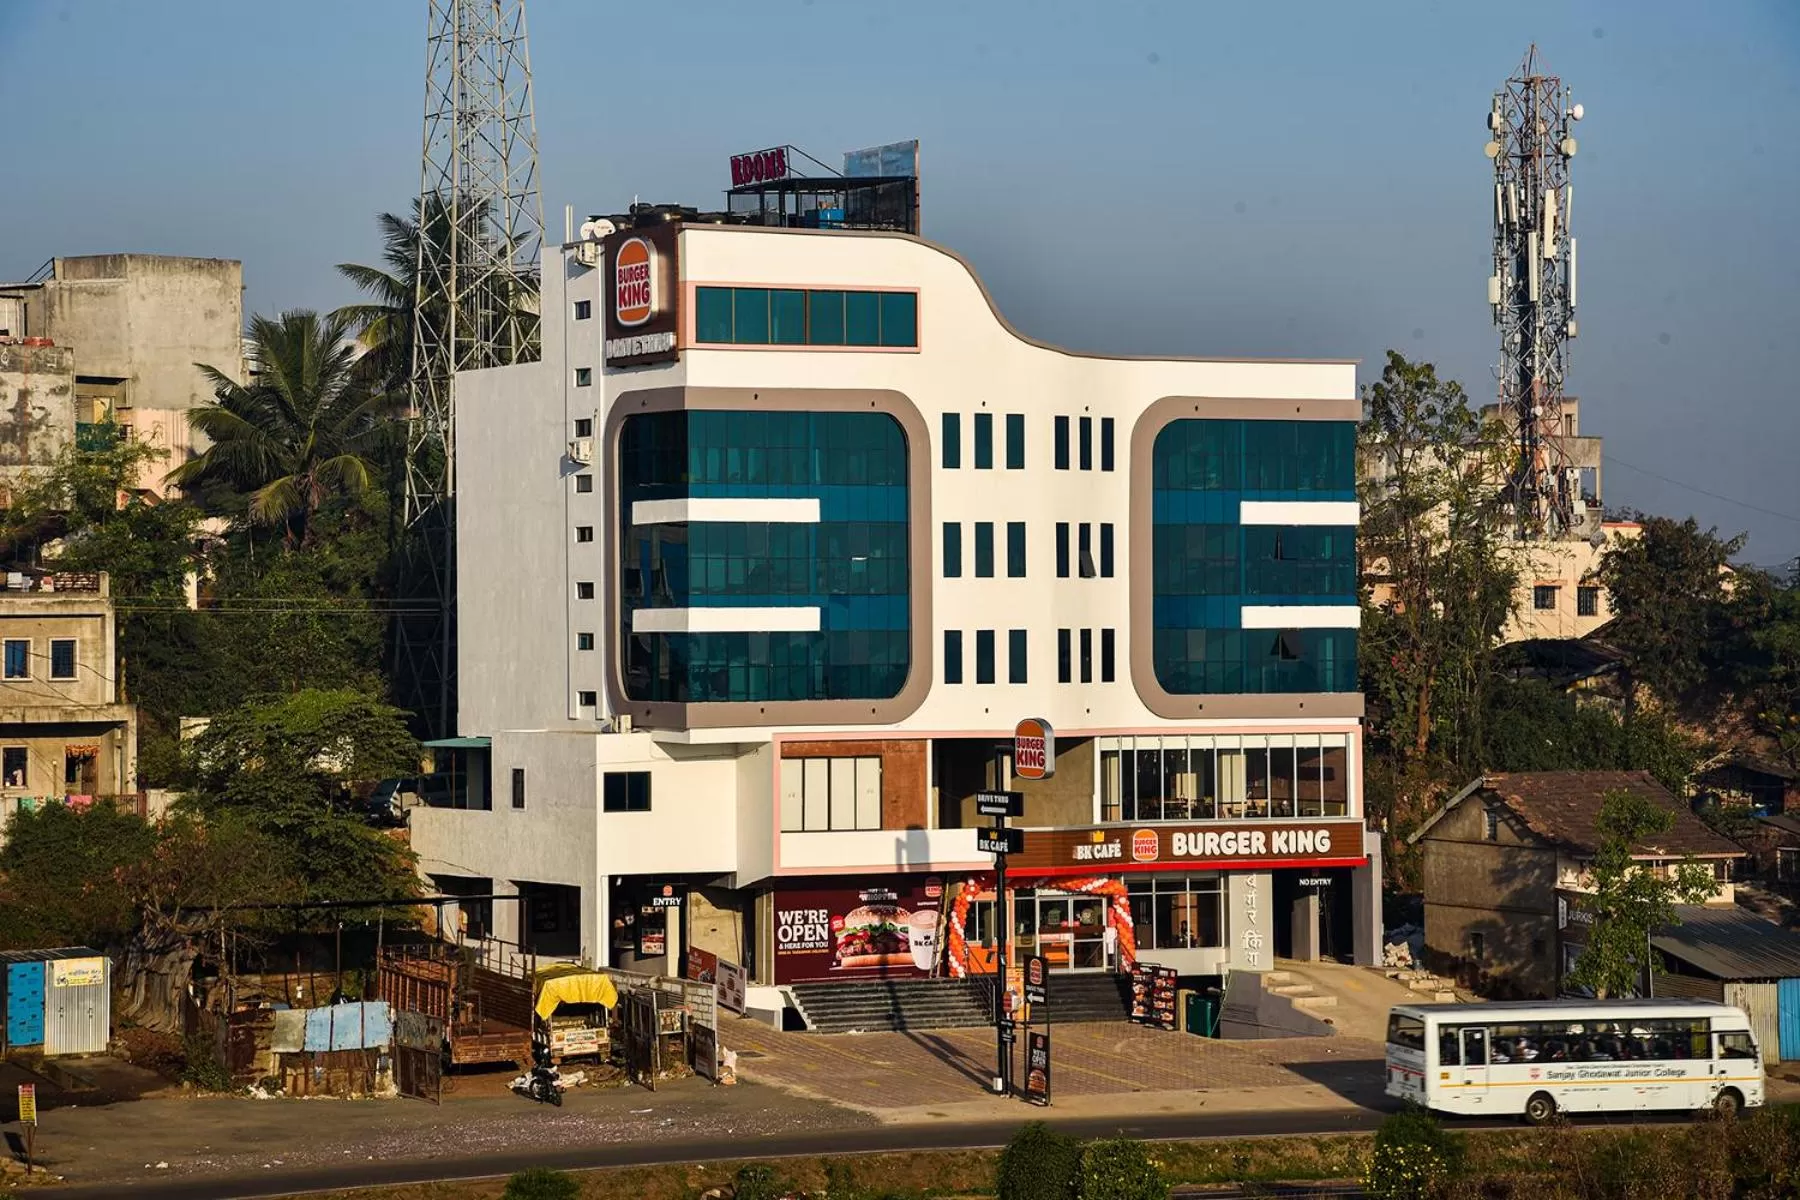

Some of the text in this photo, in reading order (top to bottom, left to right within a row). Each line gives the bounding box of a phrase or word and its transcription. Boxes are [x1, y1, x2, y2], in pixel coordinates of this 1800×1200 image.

[731, 149, 786, 186] ROOMS
[618, 264, 649, 285] BURGER
[618, 281, 650, 308] KING
[1016, 737, 1045, 750] BURGER
[1016, 749, 1045, 767] KING
[978, 794, 1009, 803] DRIVE THRU
[979, 838, 1009, 852] BK CAFÉ
[1075, 839, 1122, 860] BK CAFÉ
[1135, 845, 1157, 854] KING
[1172, 829, 1331, 856] BURGER KING
[1299, 878, 1332, 886] NO ENTRY
[653, 897, 682, 906] ENTRY
[778, 909, 828, 925] WE'RE
[777, 923, 829, 942] OPEN
[785, 942, 800, 950] HERE
[802, 941, 814, 949] FOR
[1546, 1070, 1575, 1080] Sanjay
[1624, 1068, 1650, 1078] Junior
[1654, 1067, 1687, 1078] College
